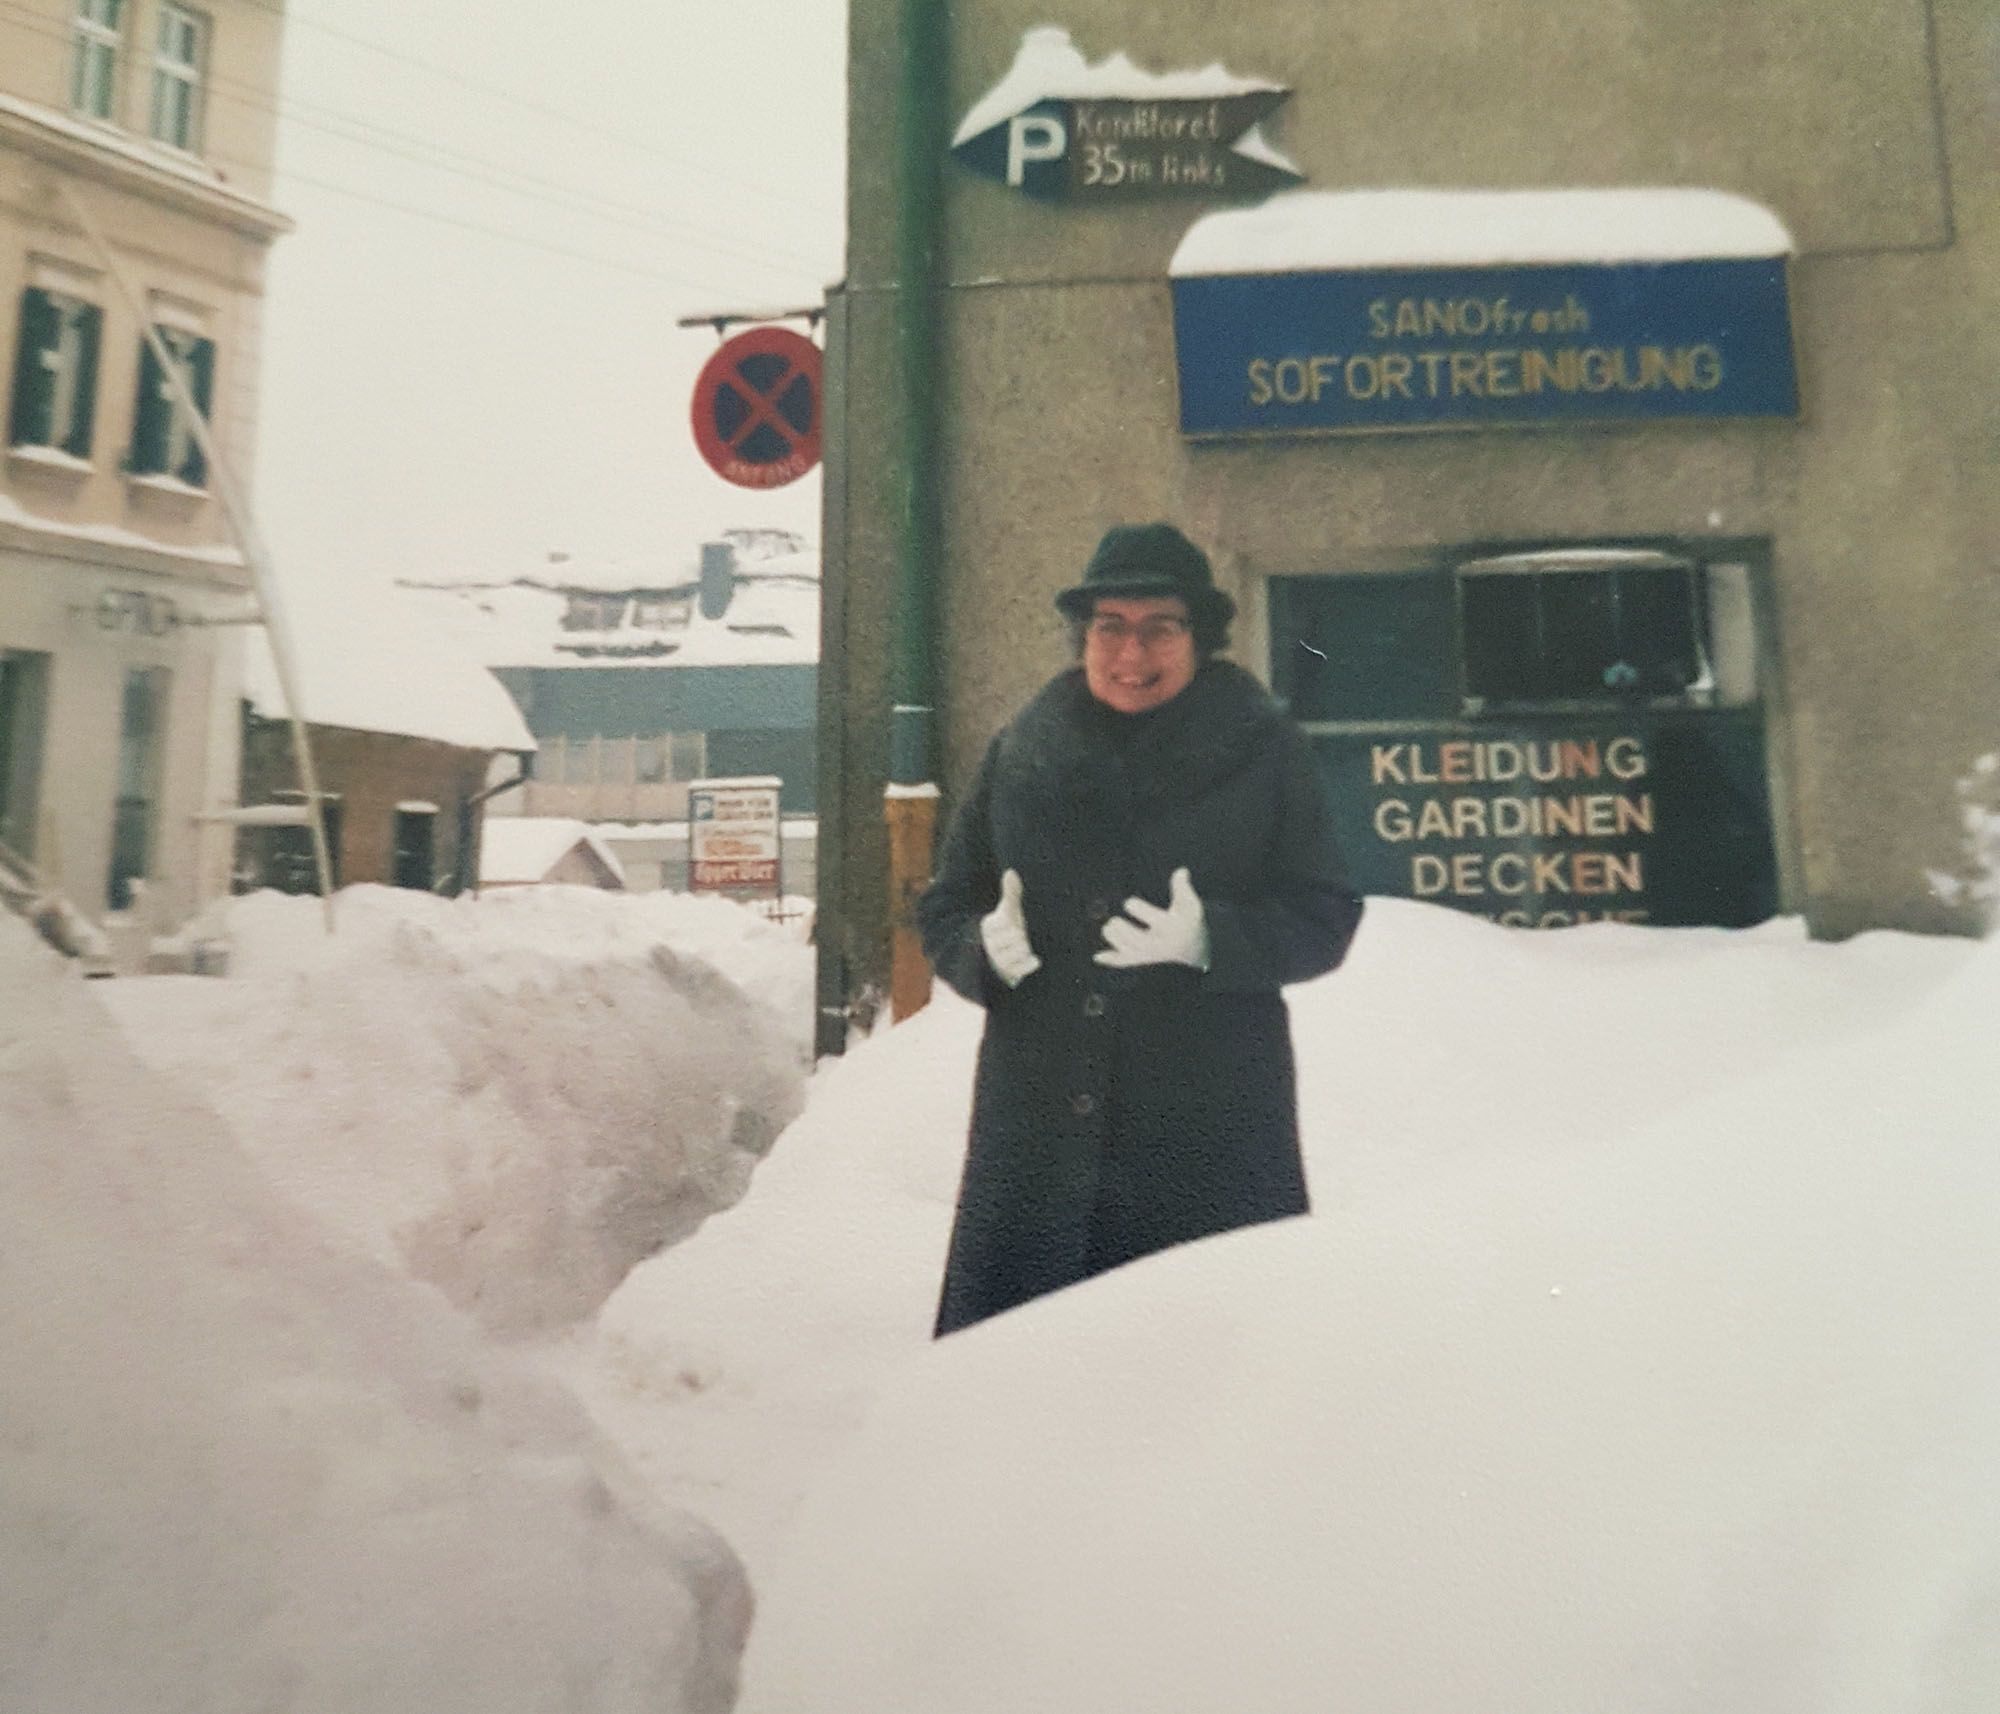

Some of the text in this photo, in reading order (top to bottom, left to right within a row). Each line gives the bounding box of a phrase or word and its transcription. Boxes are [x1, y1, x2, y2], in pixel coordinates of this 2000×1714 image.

[1006, 116, 1066, 187] P
[1162, 153, 1226, 185] links
[1247, 344, 1723, 406] SOFORTREINIGUNG
[1371, 738, 1647, 784] KLEIDUNG
[1374, 794, 1655, 842] GARDINEN
[1412, 853, 1644, 895] DECKEN
